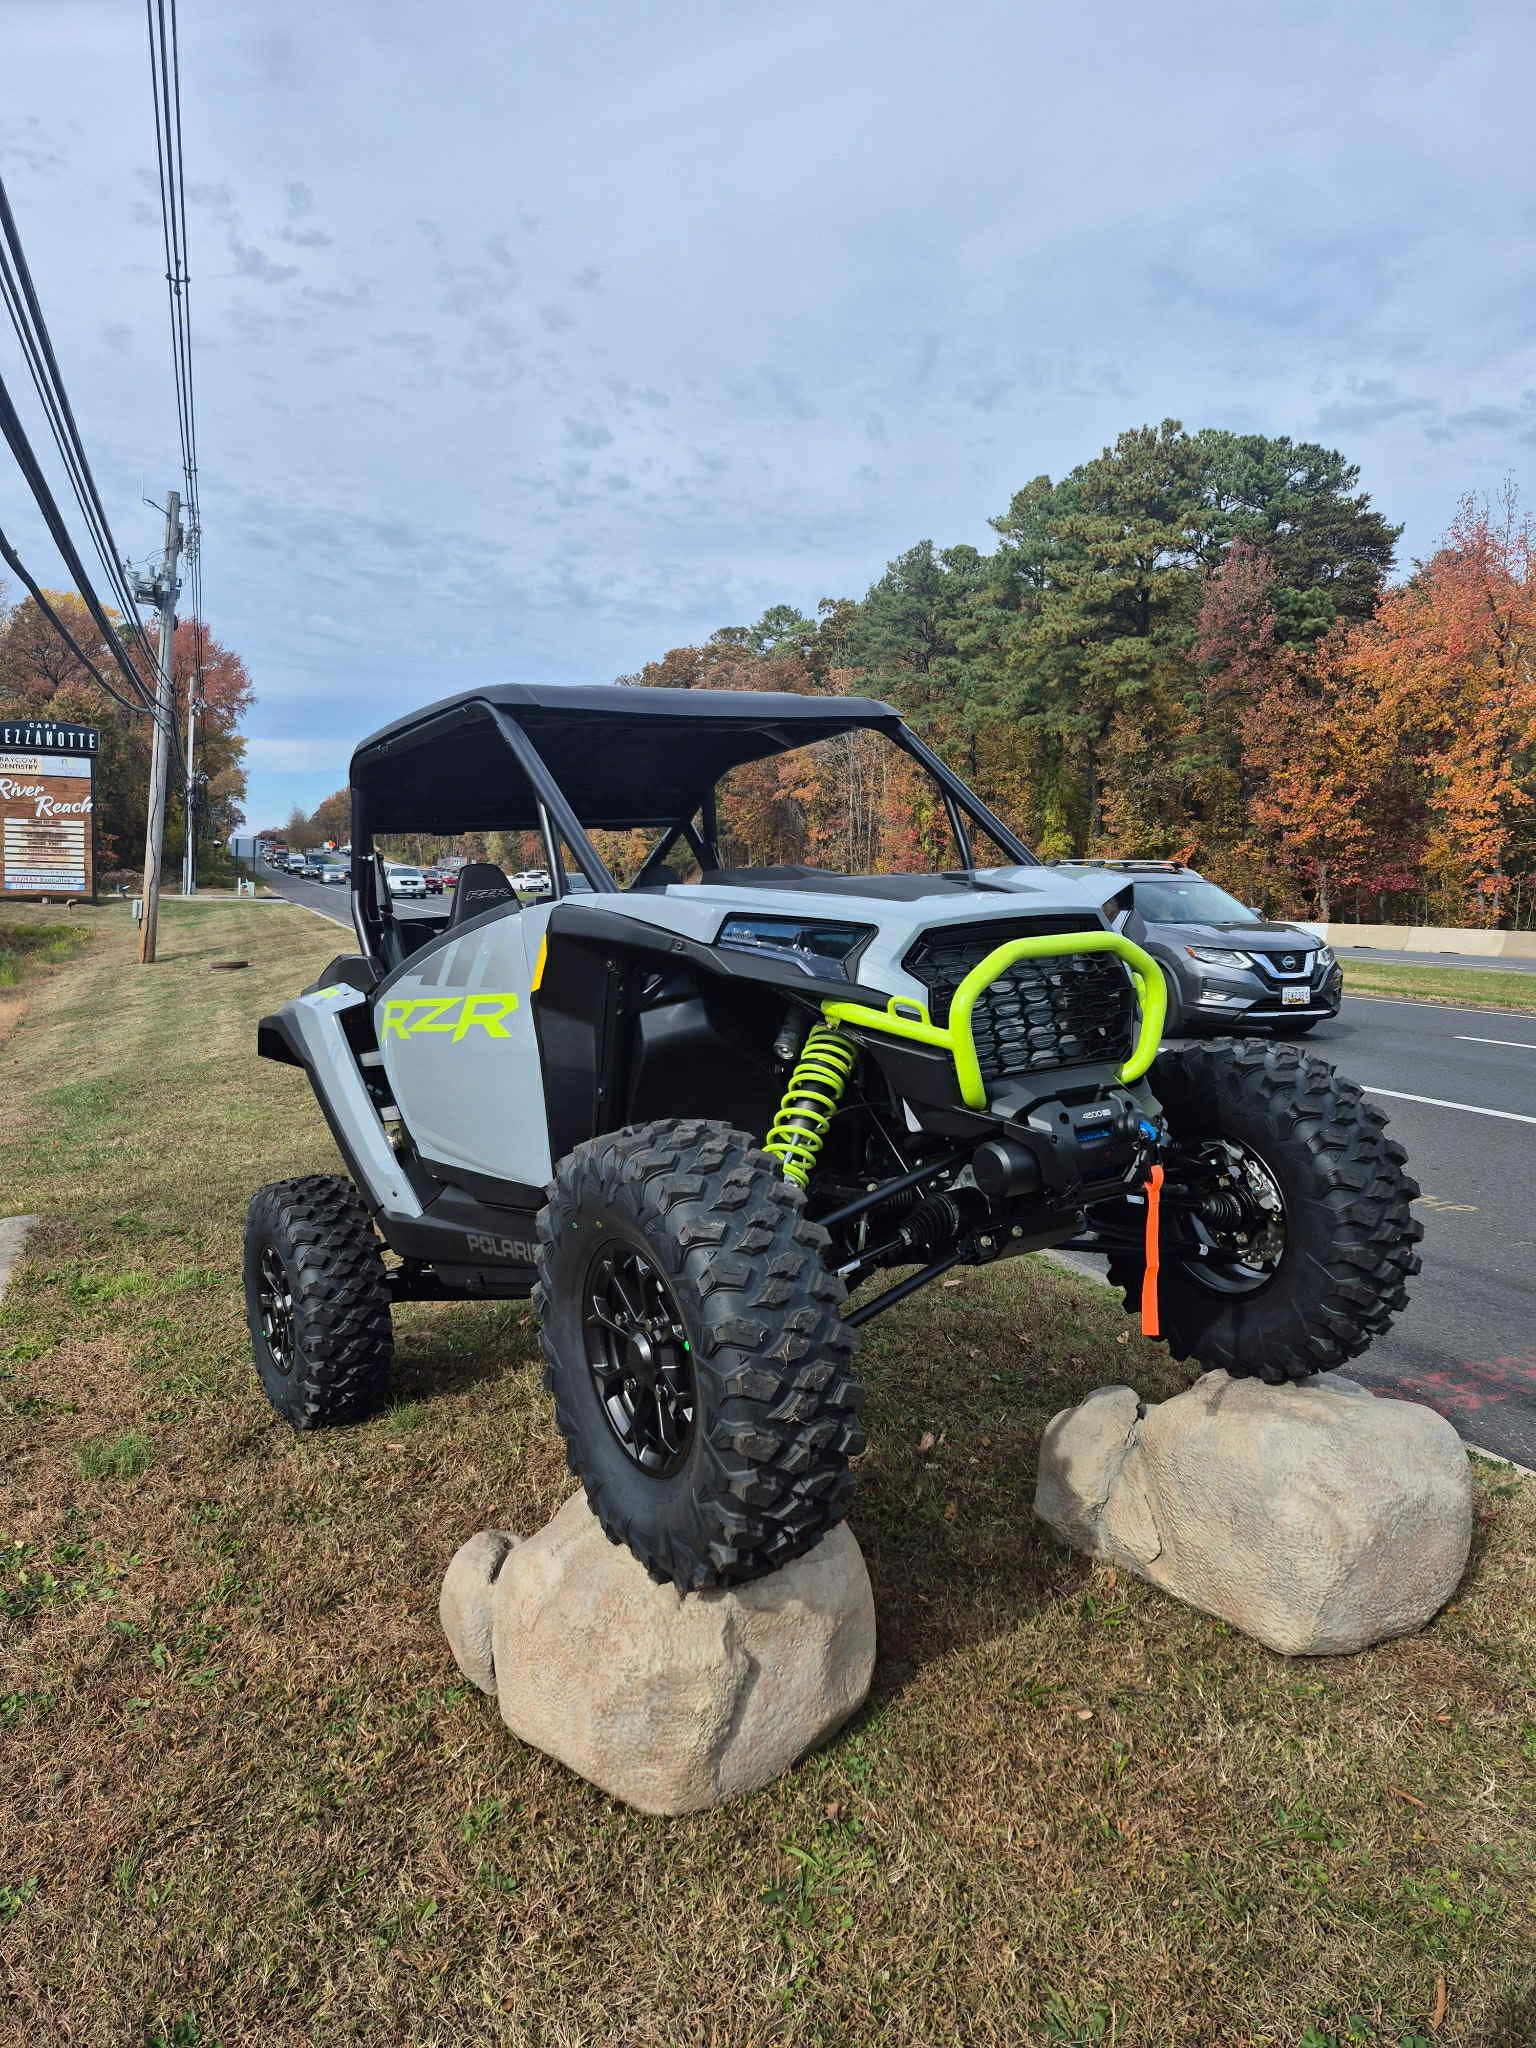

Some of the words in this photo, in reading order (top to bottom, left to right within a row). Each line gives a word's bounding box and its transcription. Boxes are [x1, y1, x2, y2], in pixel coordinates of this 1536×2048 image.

[4, 728, 95, 749] EZZANOTTE
[0, 763, 38, 771] DENTISTRY
[0, 777, 45, 800] River
[35, 796, 94, 818] Reach
[381, 992, 520, 1044] RZR
